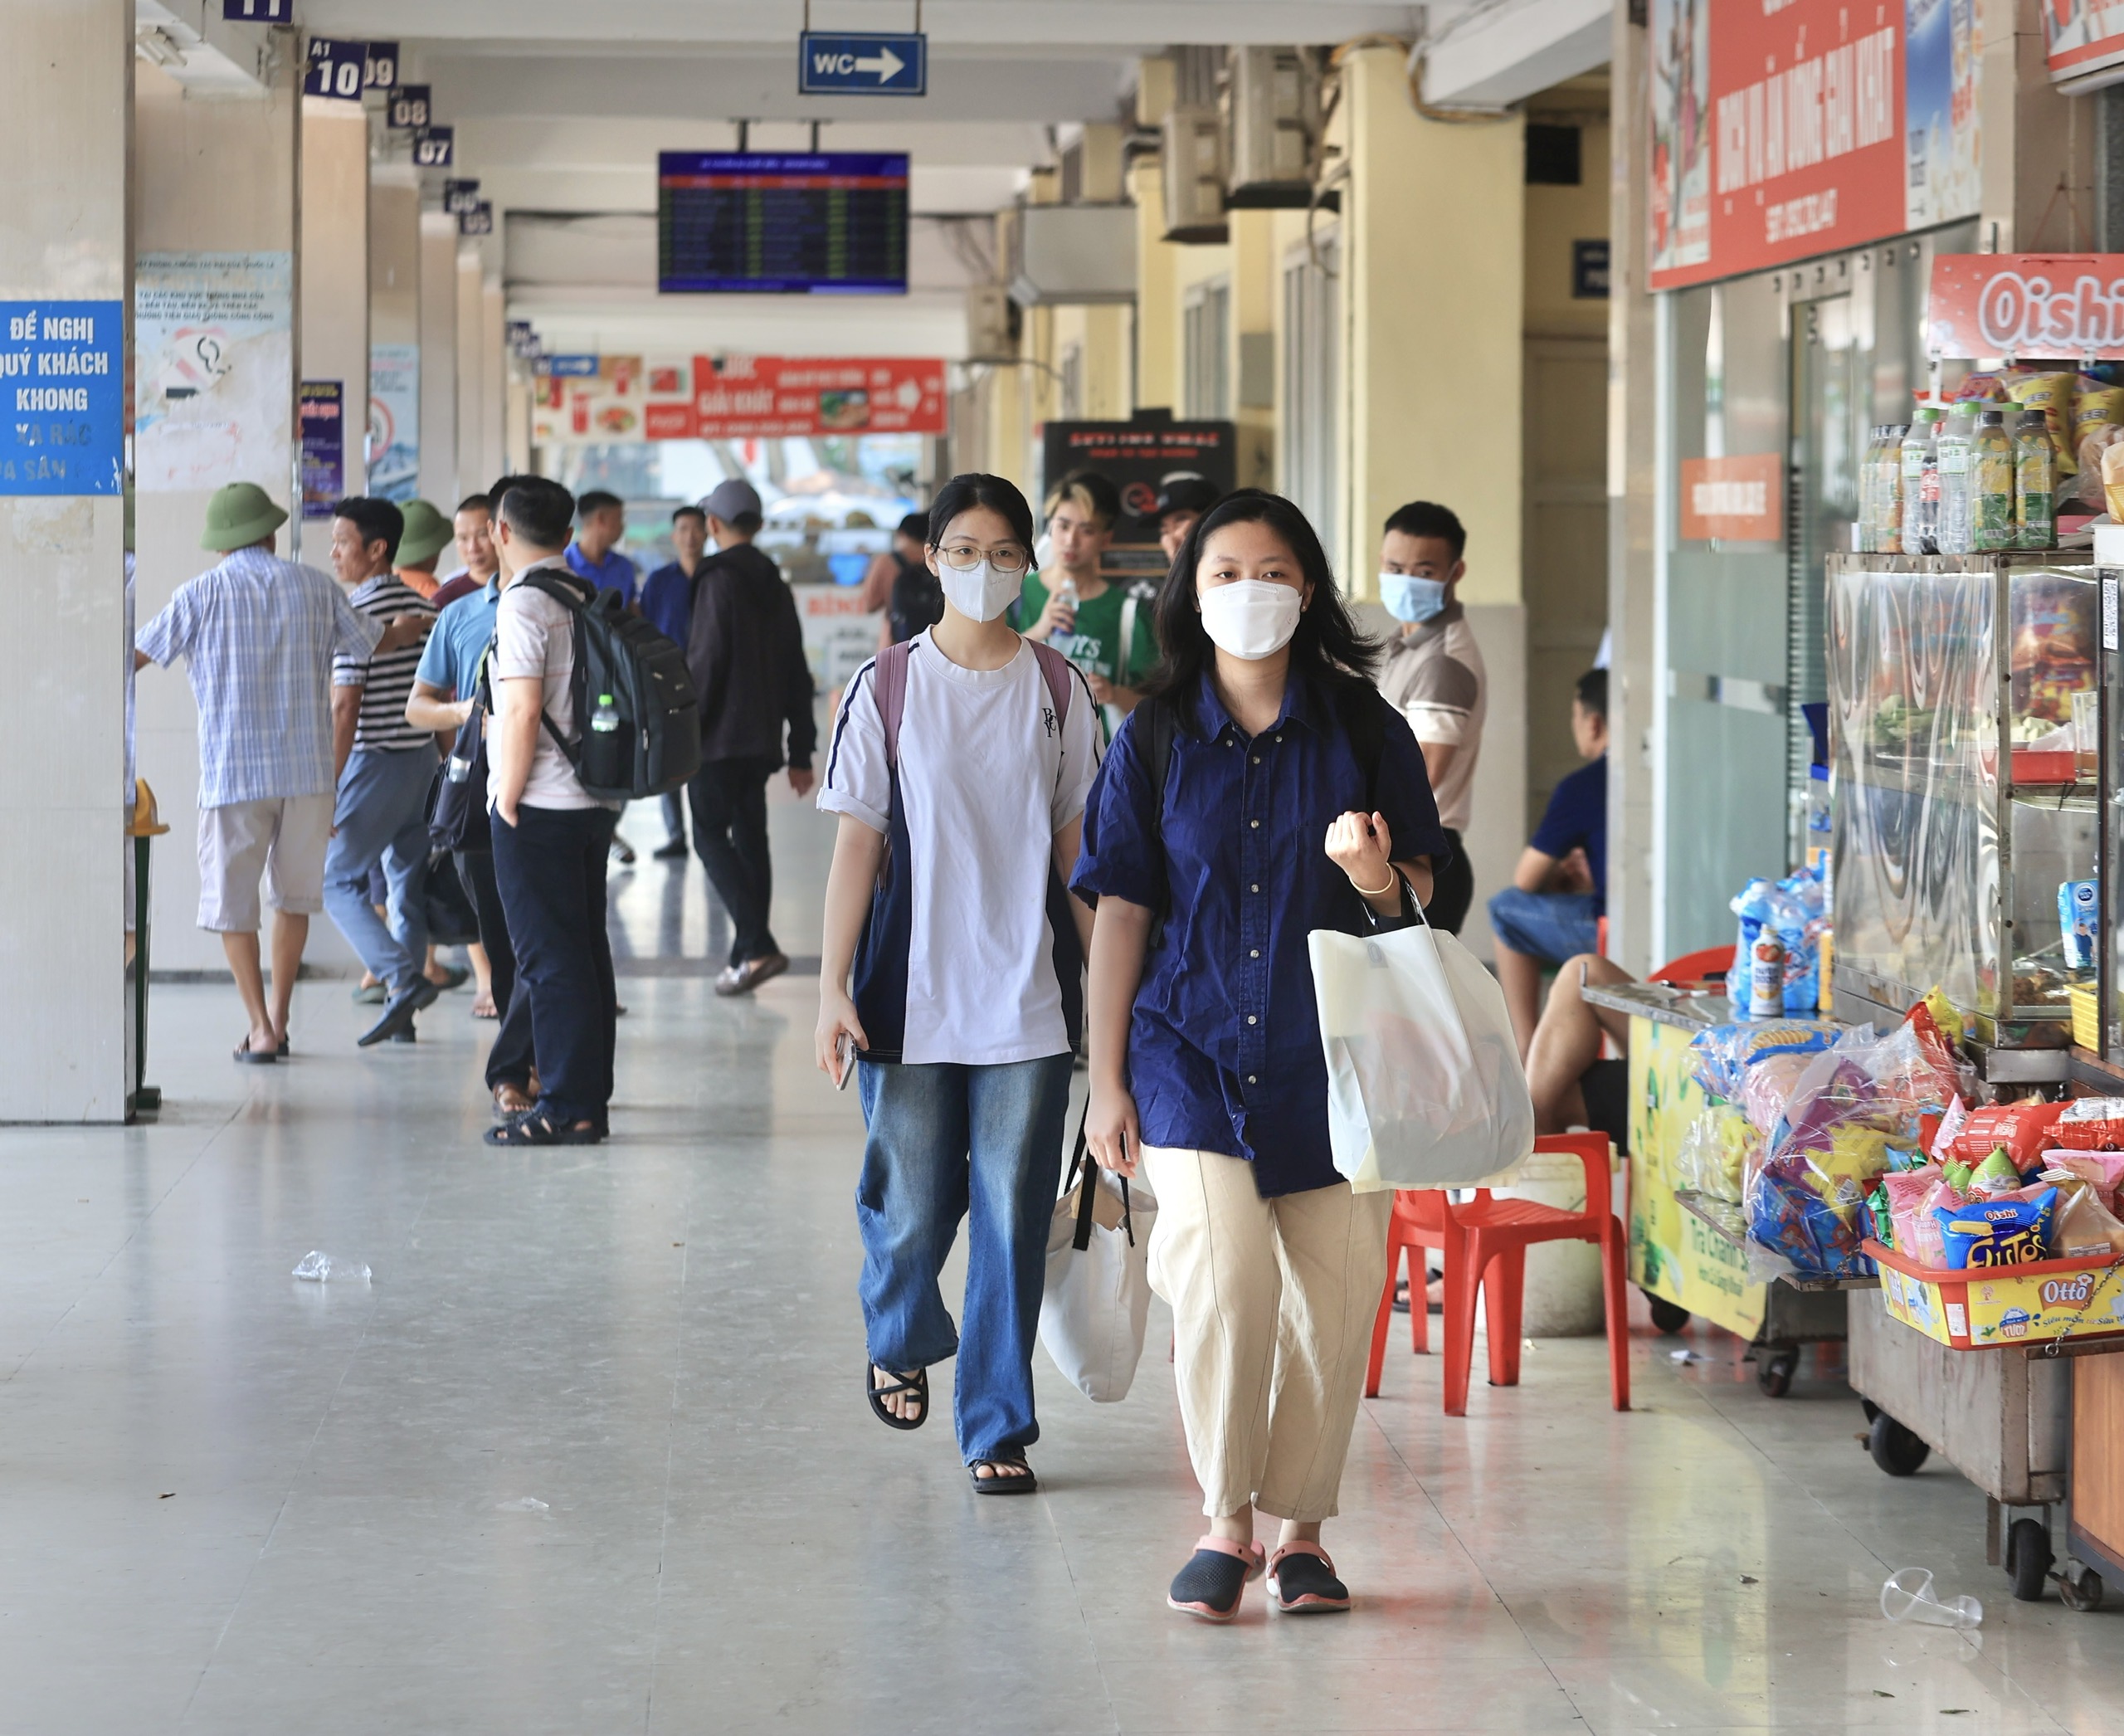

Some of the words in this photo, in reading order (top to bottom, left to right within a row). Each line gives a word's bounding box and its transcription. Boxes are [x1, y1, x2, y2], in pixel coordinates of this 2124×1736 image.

[312, 41, 330, 56] A1
[813, 53, 855, 75] WC
[318, 61, 359, 95] 10
[394, 100, 427, 125] 08
[418, 141, 451, 164] 07
[1980, 272, 2124, 349] Oishi
[43, 317, 94, 345] NGHỊ
[37, 346, 108, 376] KHÁCH
[1985, 1208, 2019, 1221] Oishi
